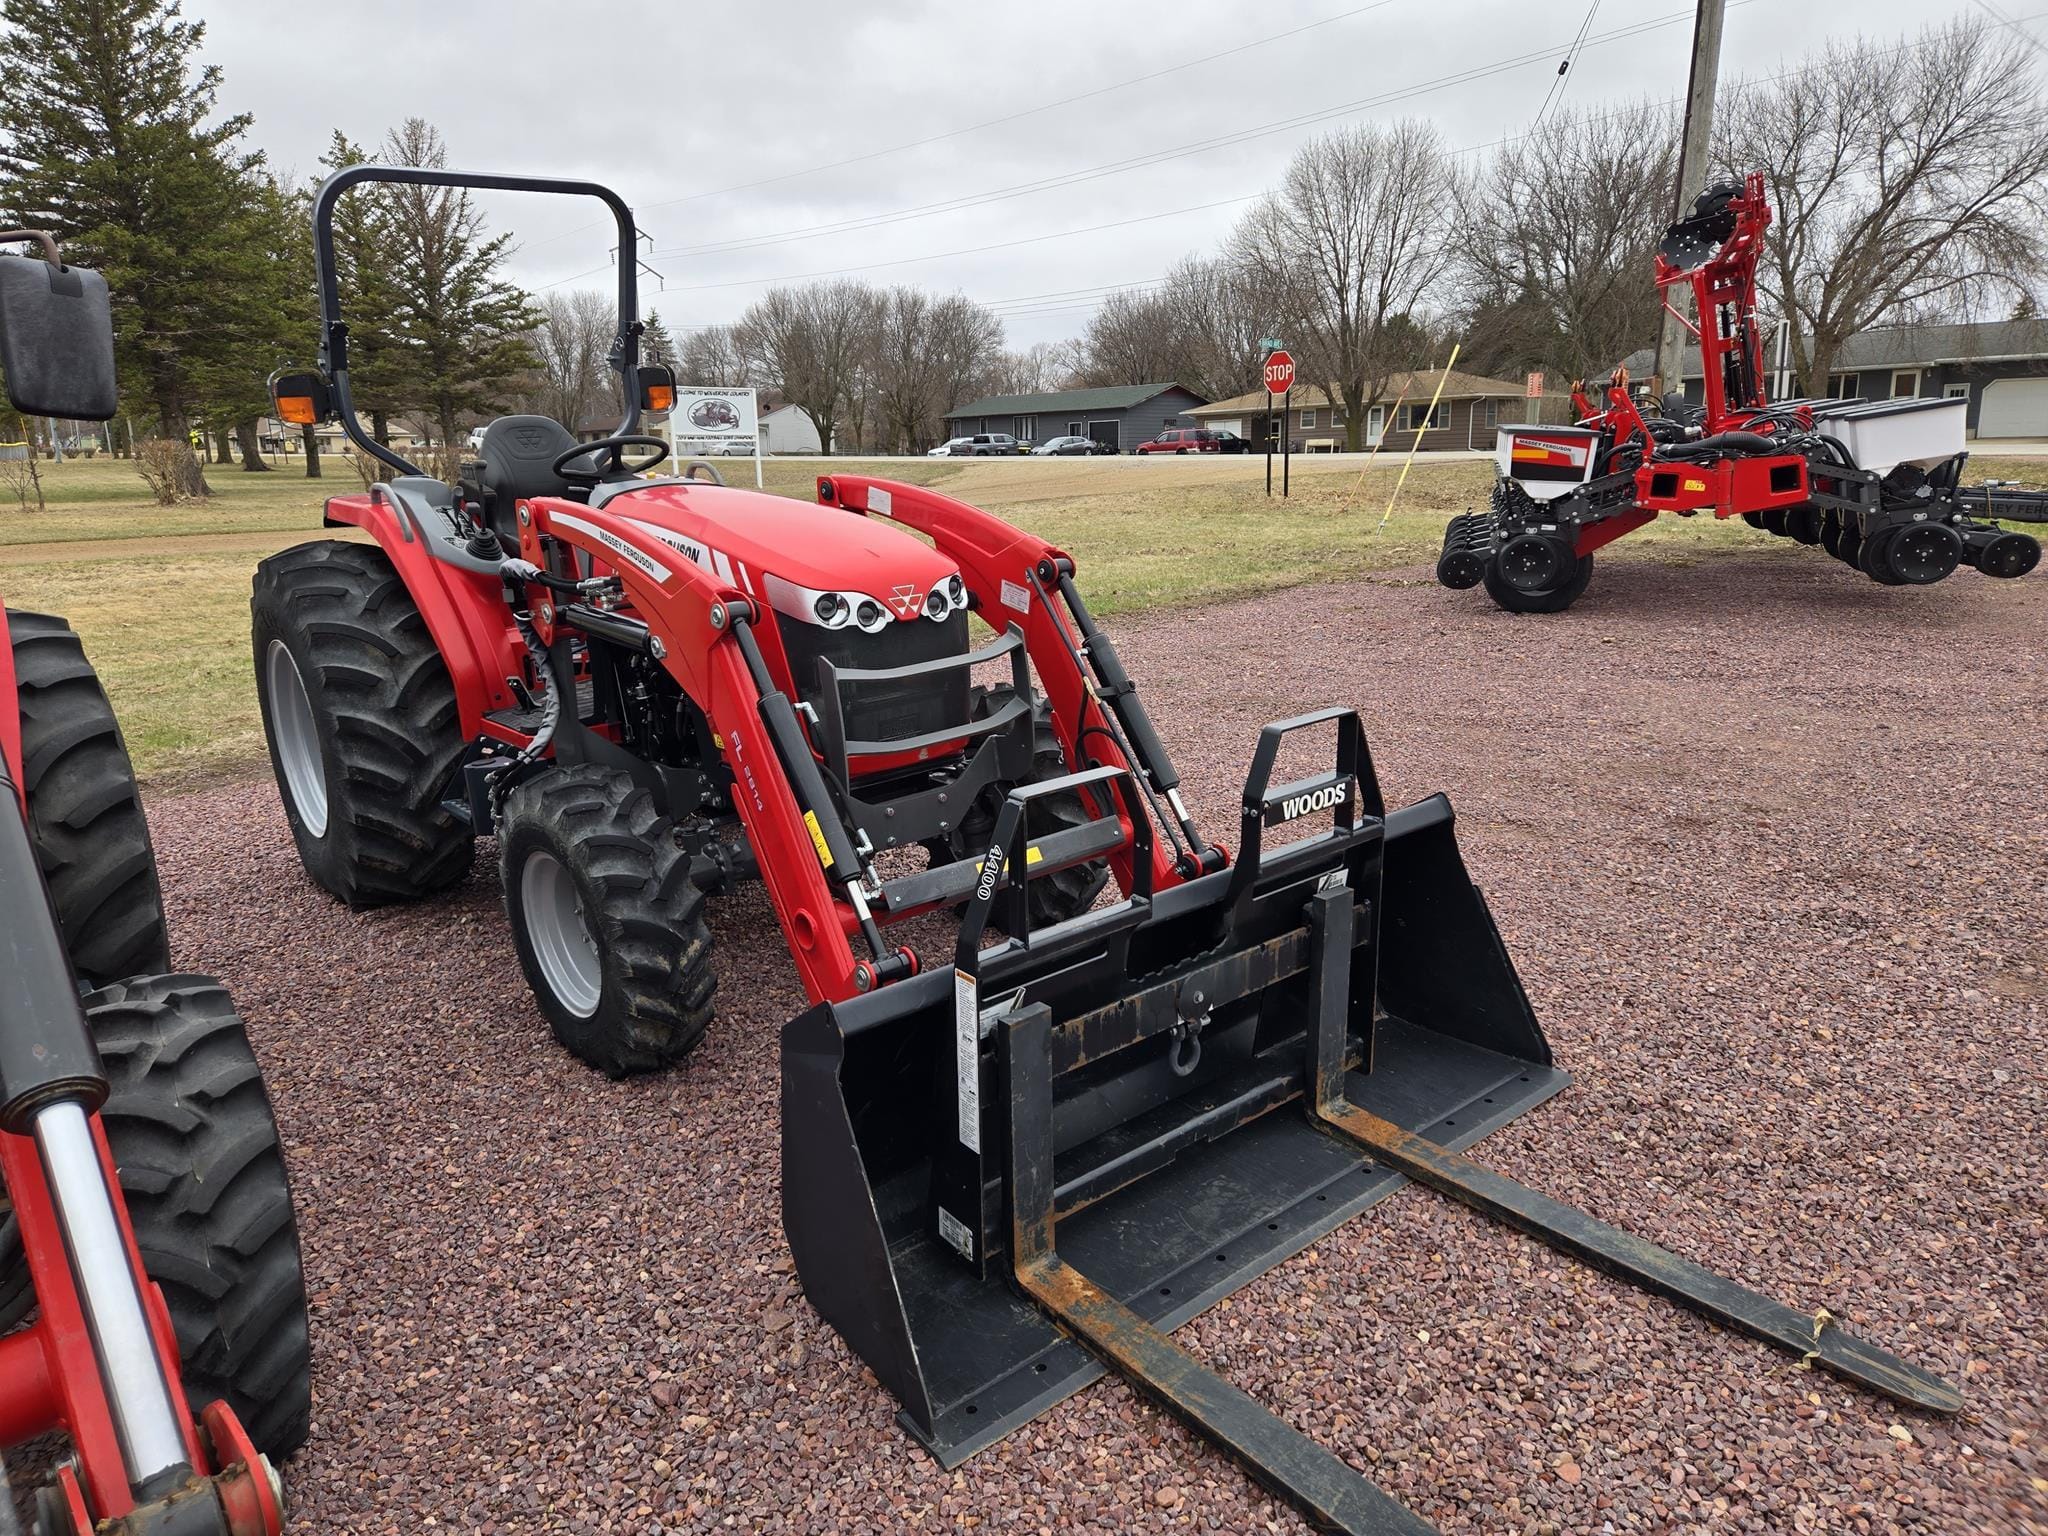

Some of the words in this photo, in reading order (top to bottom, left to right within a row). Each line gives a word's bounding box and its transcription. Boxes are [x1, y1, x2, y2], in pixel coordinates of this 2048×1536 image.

[1266, 364, 1293, 382] STOP
[1519, 439, 1542, 447] MASSEY
[1542, 443, 1572, 452] FERGUSON
[599, 530, 622, 550] MASSEY
[623, 544, 655, 572] FERGUSON
[1282, 782, 1346, 821] WOODS
[977, 844, 1003, 901] 4400
